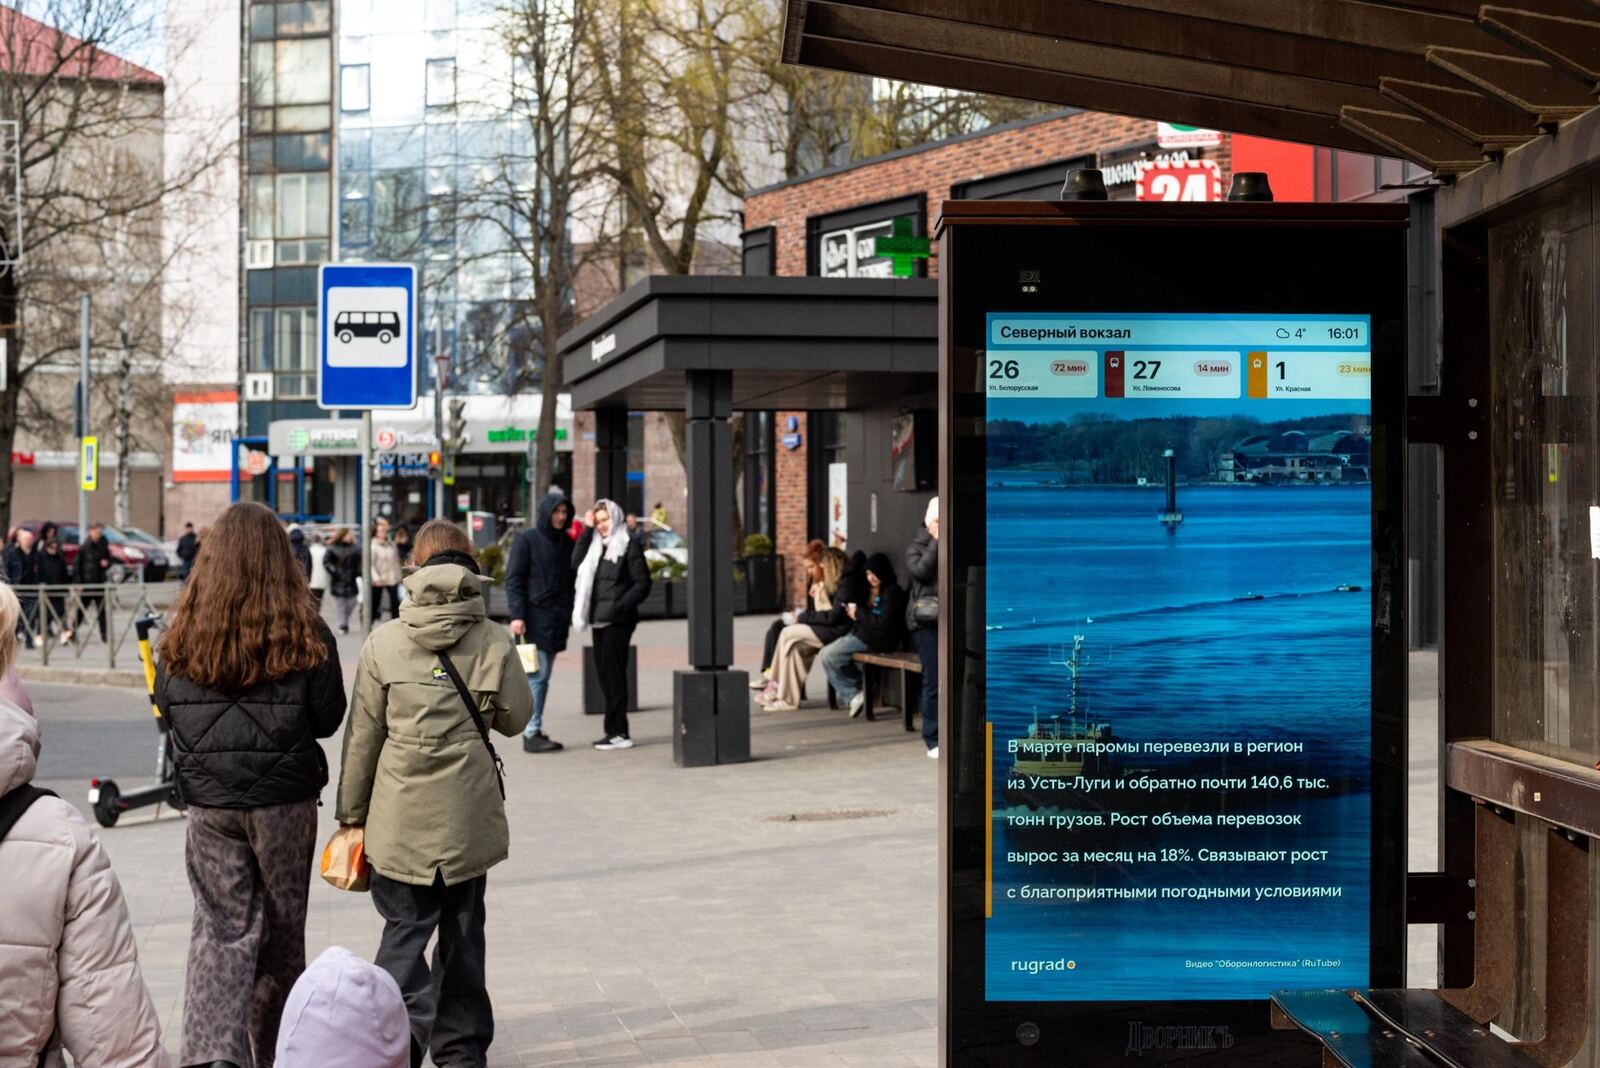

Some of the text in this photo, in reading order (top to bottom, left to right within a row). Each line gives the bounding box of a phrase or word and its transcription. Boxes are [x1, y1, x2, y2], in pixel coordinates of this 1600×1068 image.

[1151, 173, 1208, 201] 24
[1000, 325, 1131, 341] Северный вокзал
[1294, 327, 1307, 339] 4°
[1327, 327, 1359, 339] 16:01
[989, 360, 1019, 379] 26
[1053, 363, 1066, 372] 72
[1133, 361, 1162, 380] 27
[1197, 364, 1229, 373] 14 мин
[1275, 361, 1286, 380] 1
[1339, 364, 1371, 374] 23 мин
[999, 384, 1039, 392] Белорусская
[1008, 739, 1303, 757] В марте паромы перевезли в регион
[1007, 775, 1329, 793] из Усть-Луги и обратно почти 140,6 тыс.
[1007, 811, 1302, 830] тонн грузов. Рост объема перевозок
[1007, 848, 1329, 866] вырос за месяц на 18%. Связывают рост
[1007, 884, 1342, 902] с благоприятными погодными условиями
[1011, 957, 1066, 974] rugrad
[1185, 959, 1341, 969] Видео "Оборонлогистика" (RuTube)
